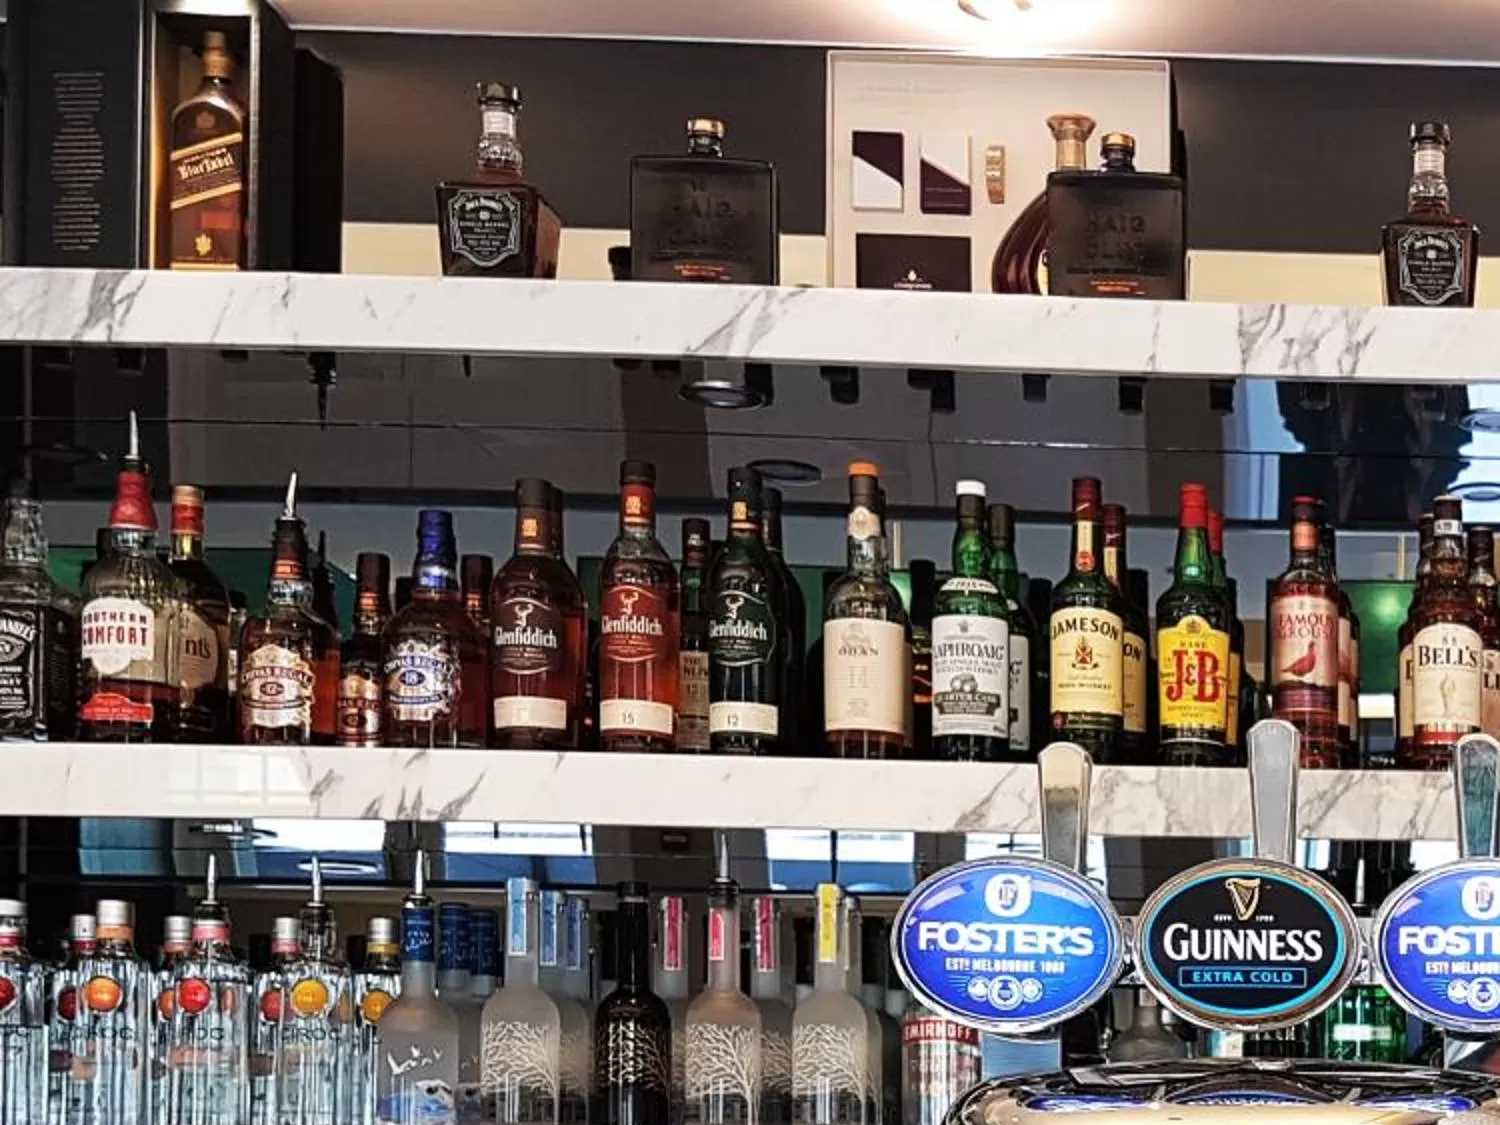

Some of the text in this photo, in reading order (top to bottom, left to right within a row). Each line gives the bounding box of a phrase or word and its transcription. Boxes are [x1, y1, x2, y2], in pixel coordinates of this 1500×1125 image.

[83, 627, 149, 647] COMFORT
[602, 615, 663, 636] Glenfiddich
[1052, 617, 1119, 642] JAMESON
[494, 626, 558, 649] Glenfiddich
[1419, 645, 1479, 668] BELL'S
[1166, 650, 1229, 702] J&B
[918, 921, 1094, 957] FOSTER'S
[1163, 923, 1323, 961] GUINNESS
[1192, 971, 1294, 983] EXTRA COLD
